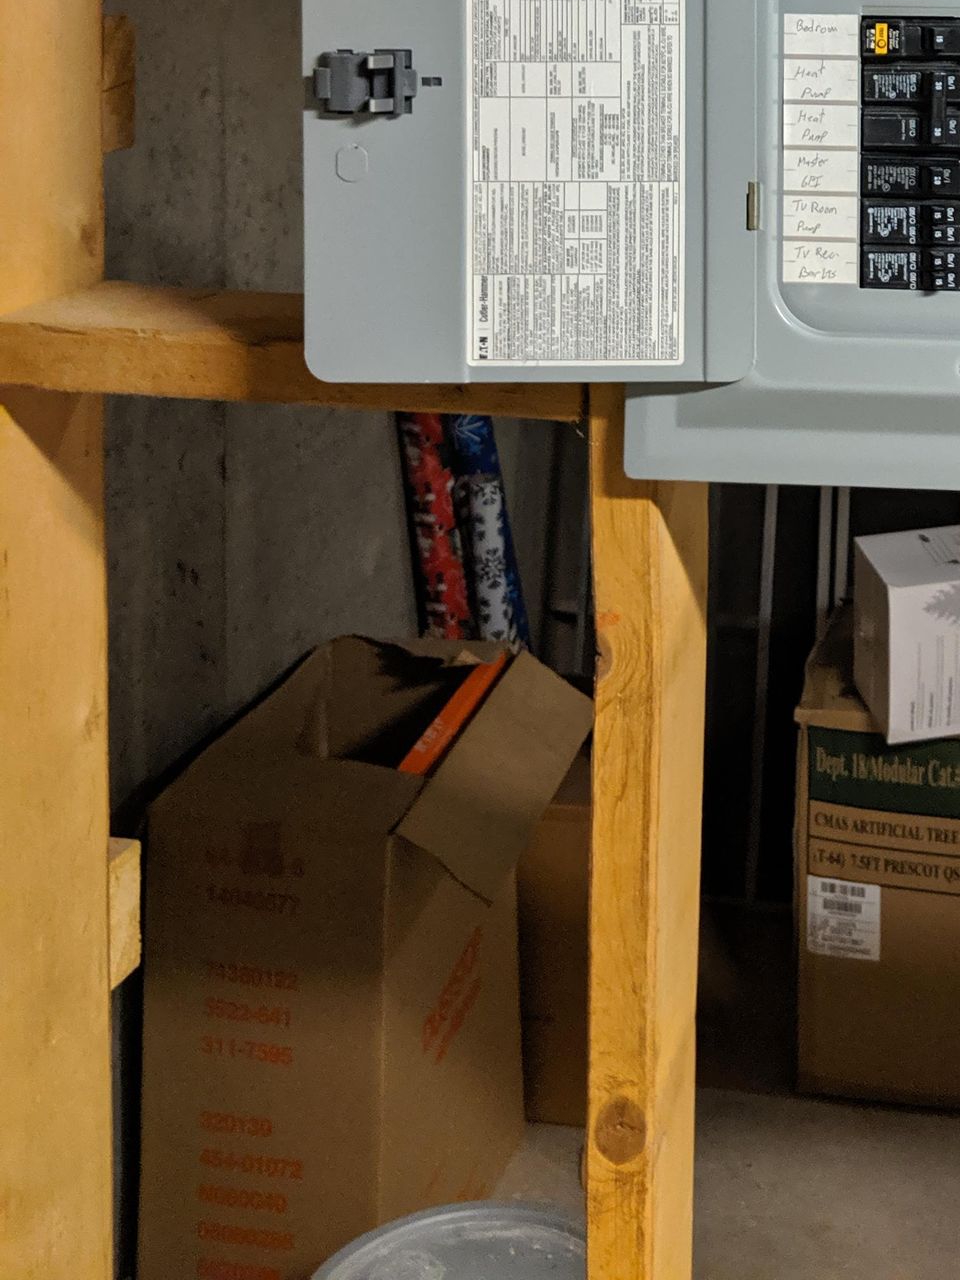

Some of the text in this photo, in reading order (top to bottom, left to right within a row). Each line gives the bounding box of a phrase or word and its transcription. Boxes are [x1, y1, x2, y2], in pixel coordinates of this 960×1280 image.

[936, 35, 944, 43] 15
[794, 59, 827, 79] Heat
[800, 87, 833, 100] Pump
[935, 81, 943, 91] 30
[797, 107, 826, 125] Heat
[801, 128, 829, 144] Pump
[934, 127, 942, 137] 30
[933, 176, 942, 185] 20
[810, 200, 838, 215] Room
[934, 230, 942, 238] 15
[935, 278, 944, 286] 15
[478, 275, 489, 323] Cutler-Hammer
[815, 745, 848, 782] Dept.
[814, 811, 960, 845] CMAS ARTIFICIAL TREE
[850, 853, 881, 872] 7.5FT
[883, 858, 941, 879] PRESCOT
